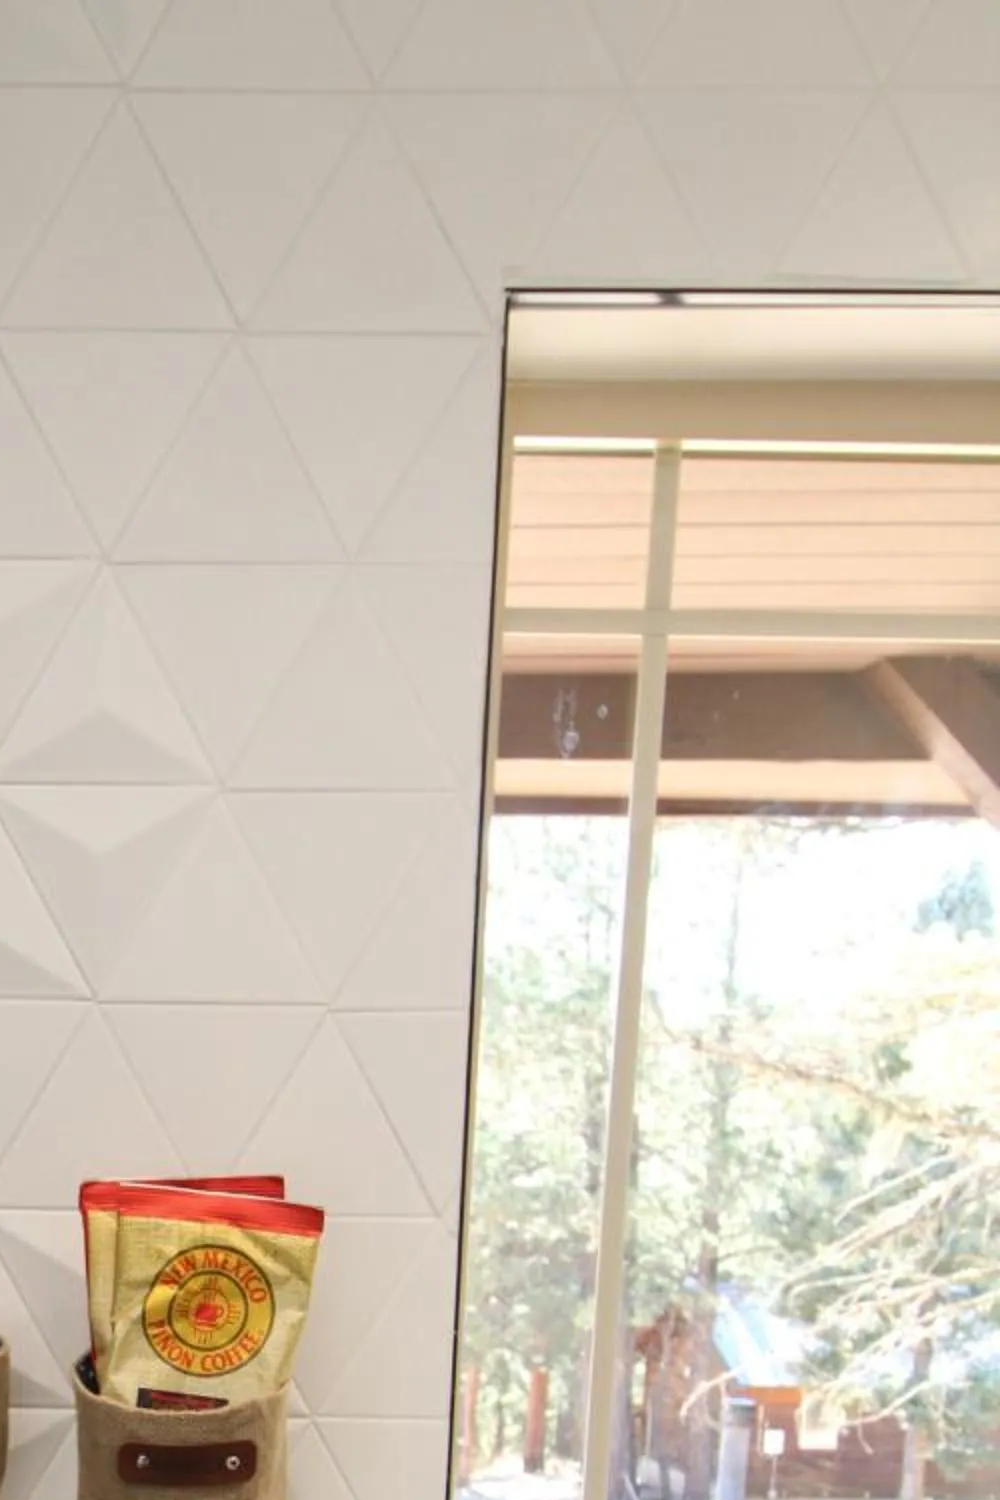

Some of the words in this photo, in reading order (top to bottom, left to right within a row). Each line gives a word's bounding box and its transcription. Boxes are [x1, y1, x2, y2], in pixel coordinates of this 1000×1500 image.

[159, 1254, 197, 1286] NEW
[203, 1249, 267, 1303] MEXICO
[199, 1331, 262, 1373] COFFEE
